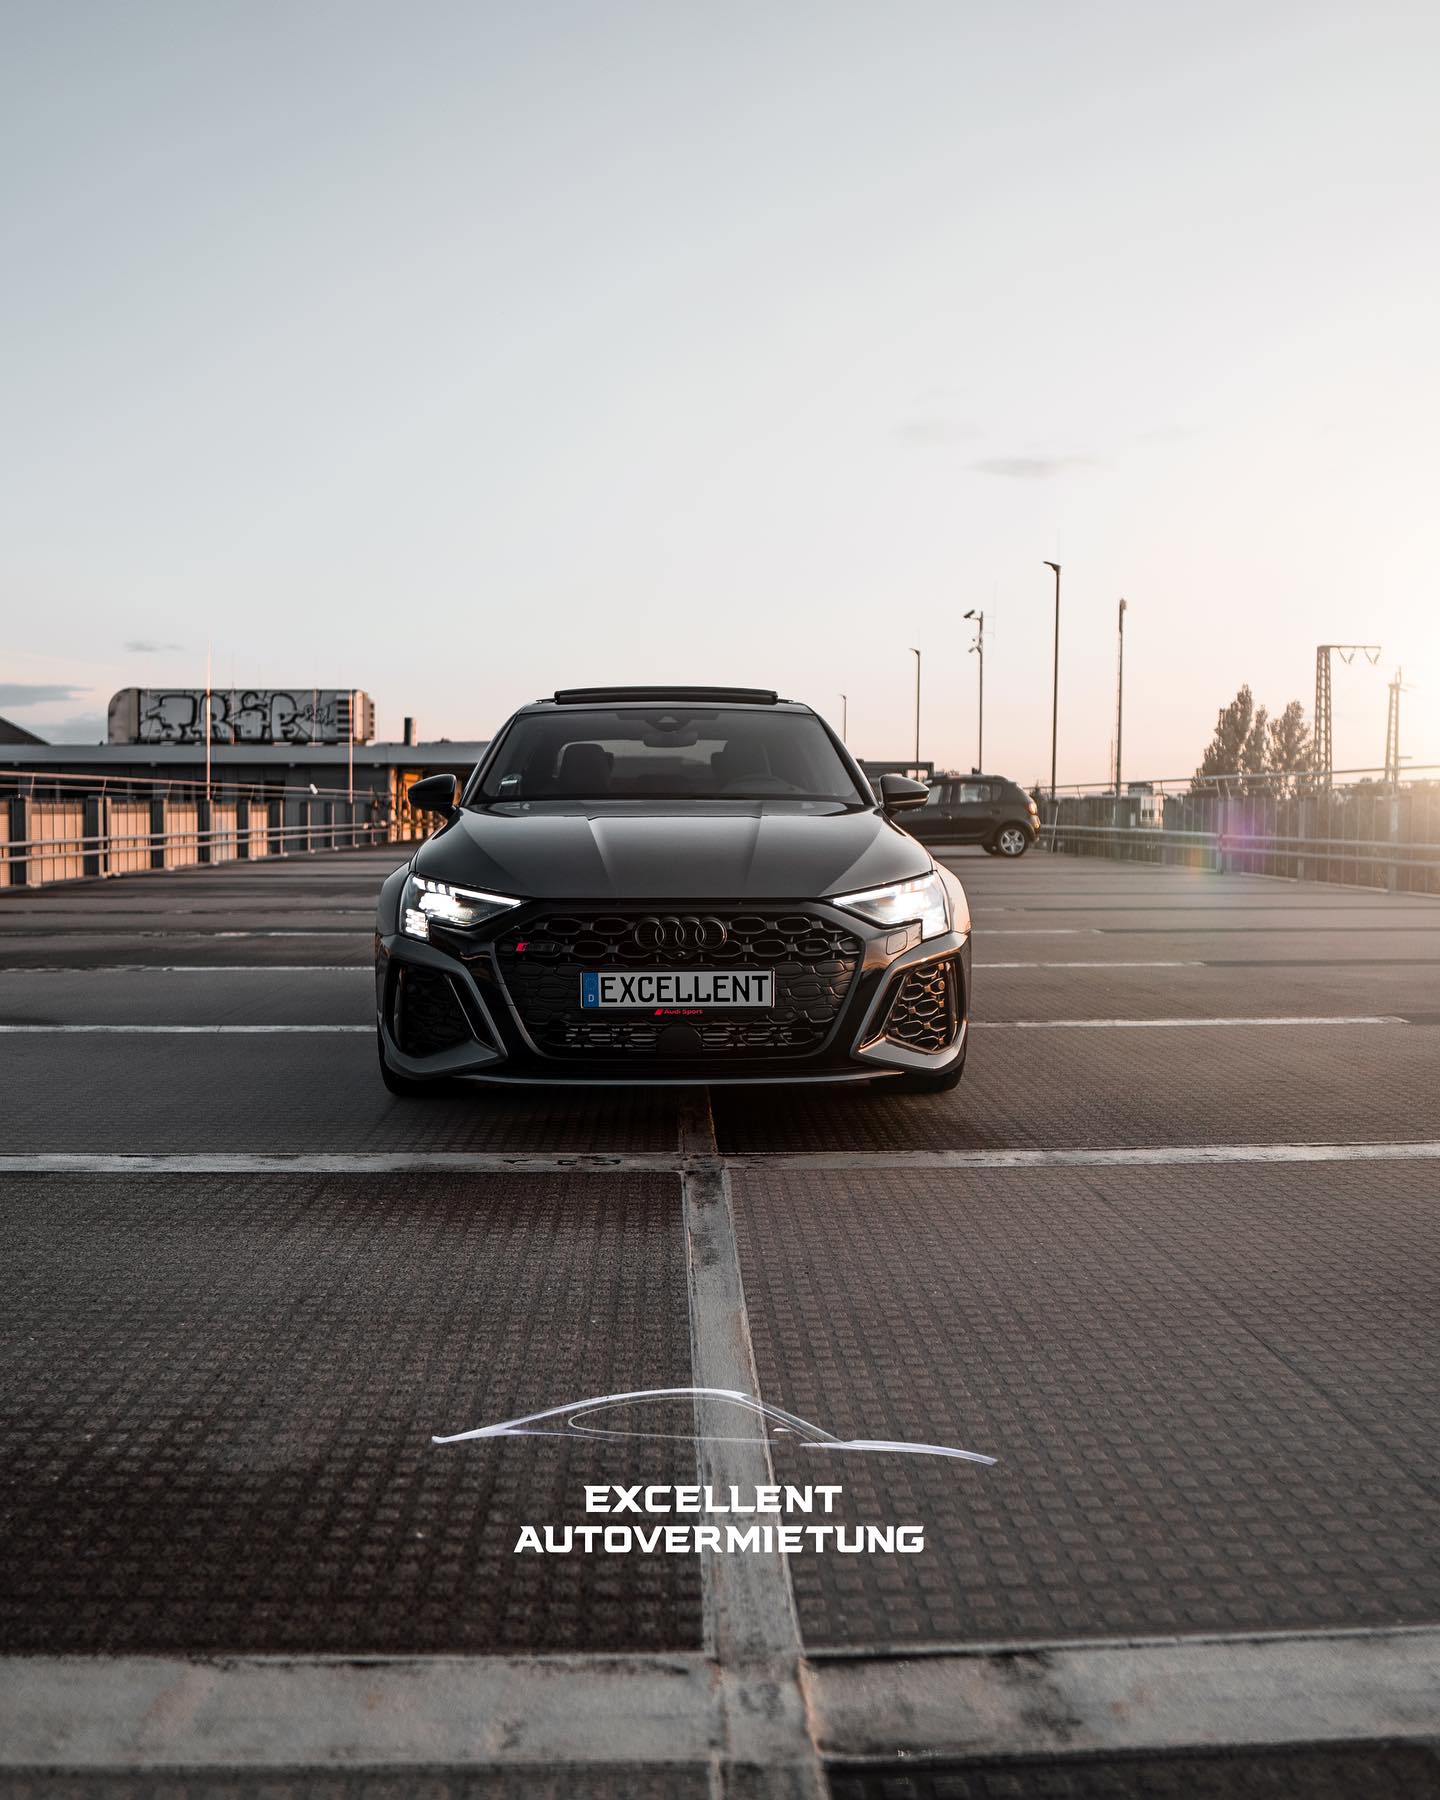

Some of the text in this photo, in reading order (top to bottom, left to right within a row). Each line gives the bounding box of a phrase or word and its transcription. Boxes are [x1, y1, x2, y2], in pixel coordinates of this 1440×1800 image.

[588, 976, 769, 1003] D EXCELLENT
[682, 1008, 704, 1016] Sport
